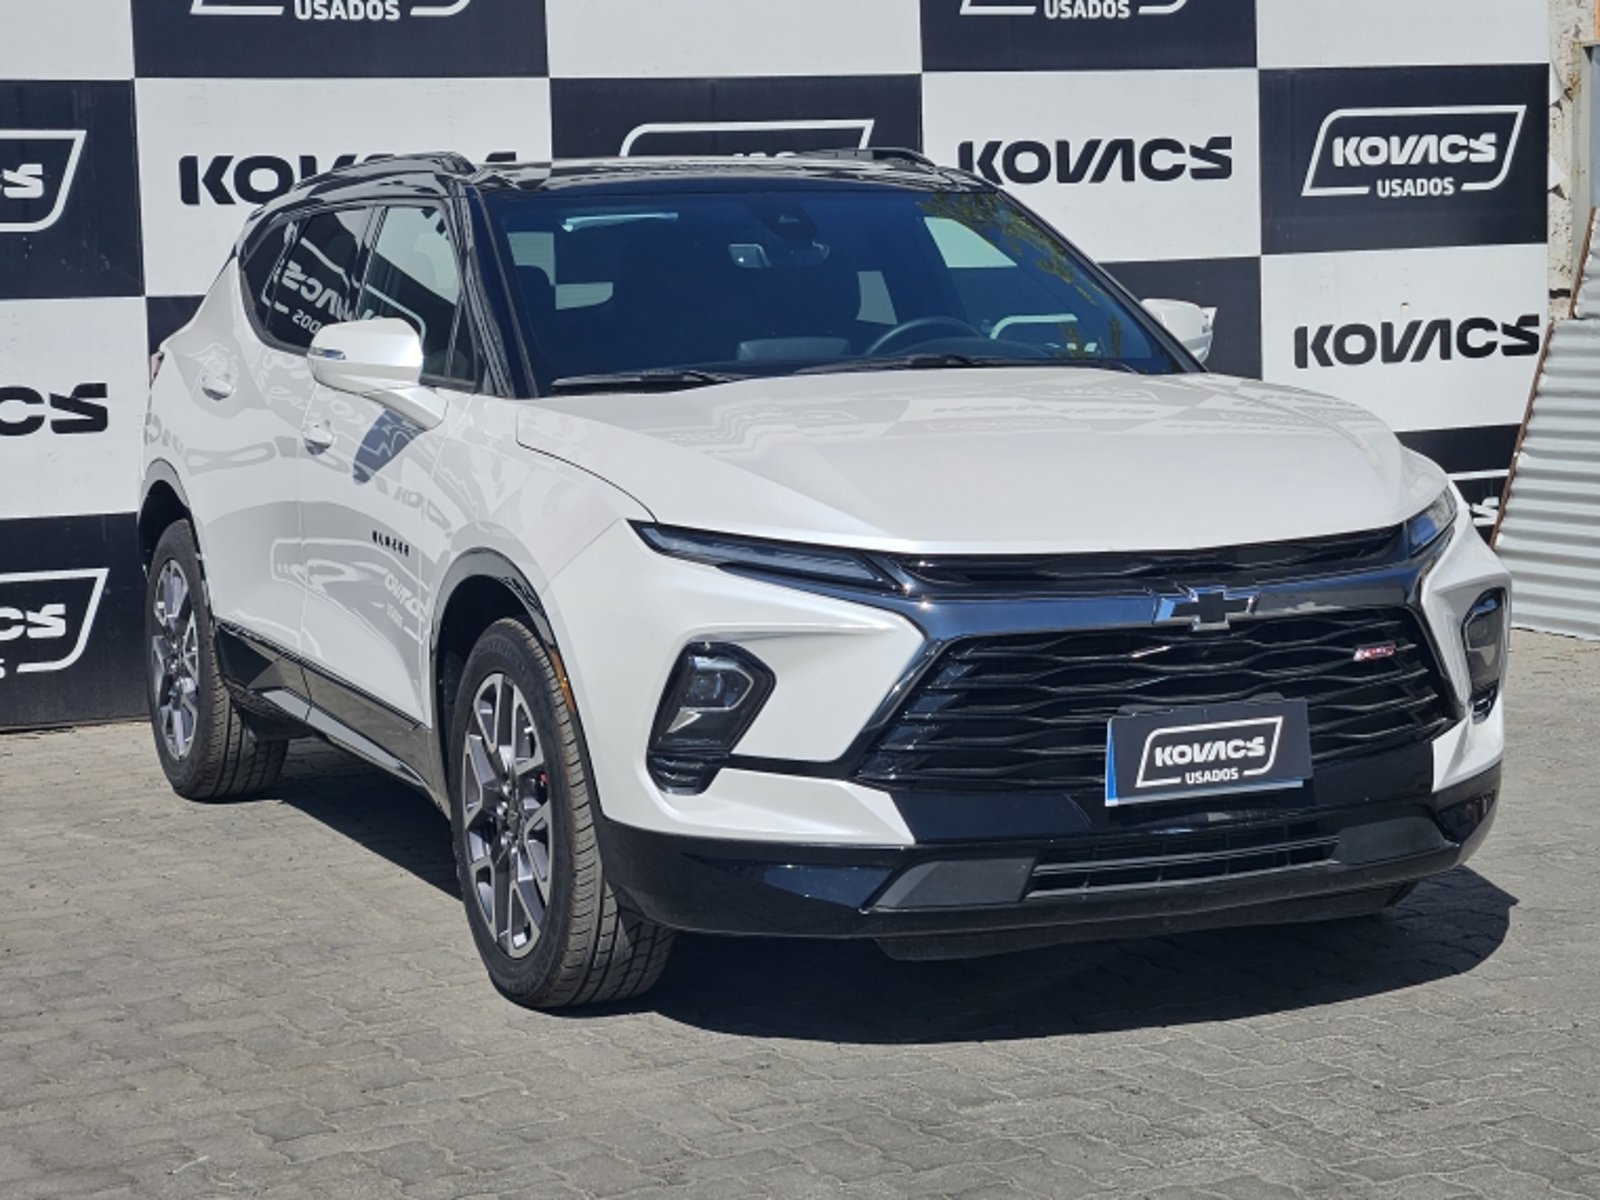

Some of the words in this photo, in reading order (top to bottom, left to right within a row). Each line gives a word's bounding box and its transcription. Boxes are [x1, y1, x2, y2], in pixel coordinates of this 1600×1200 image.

[294, 0, 400, 21] USADOS
[1044, 0, 1131, 19] USADOS
[958, 136, 1232, 185] KOVACS
[1333, 132, 1497, 167] KOVACS
[1376, 177, 1454, 198] USADOS
[1294, 314, 1539, 369] KOVACS
[1154, 736, 1266, 767] KOVACS
[1185, 768, 1239, 785] USADOS
